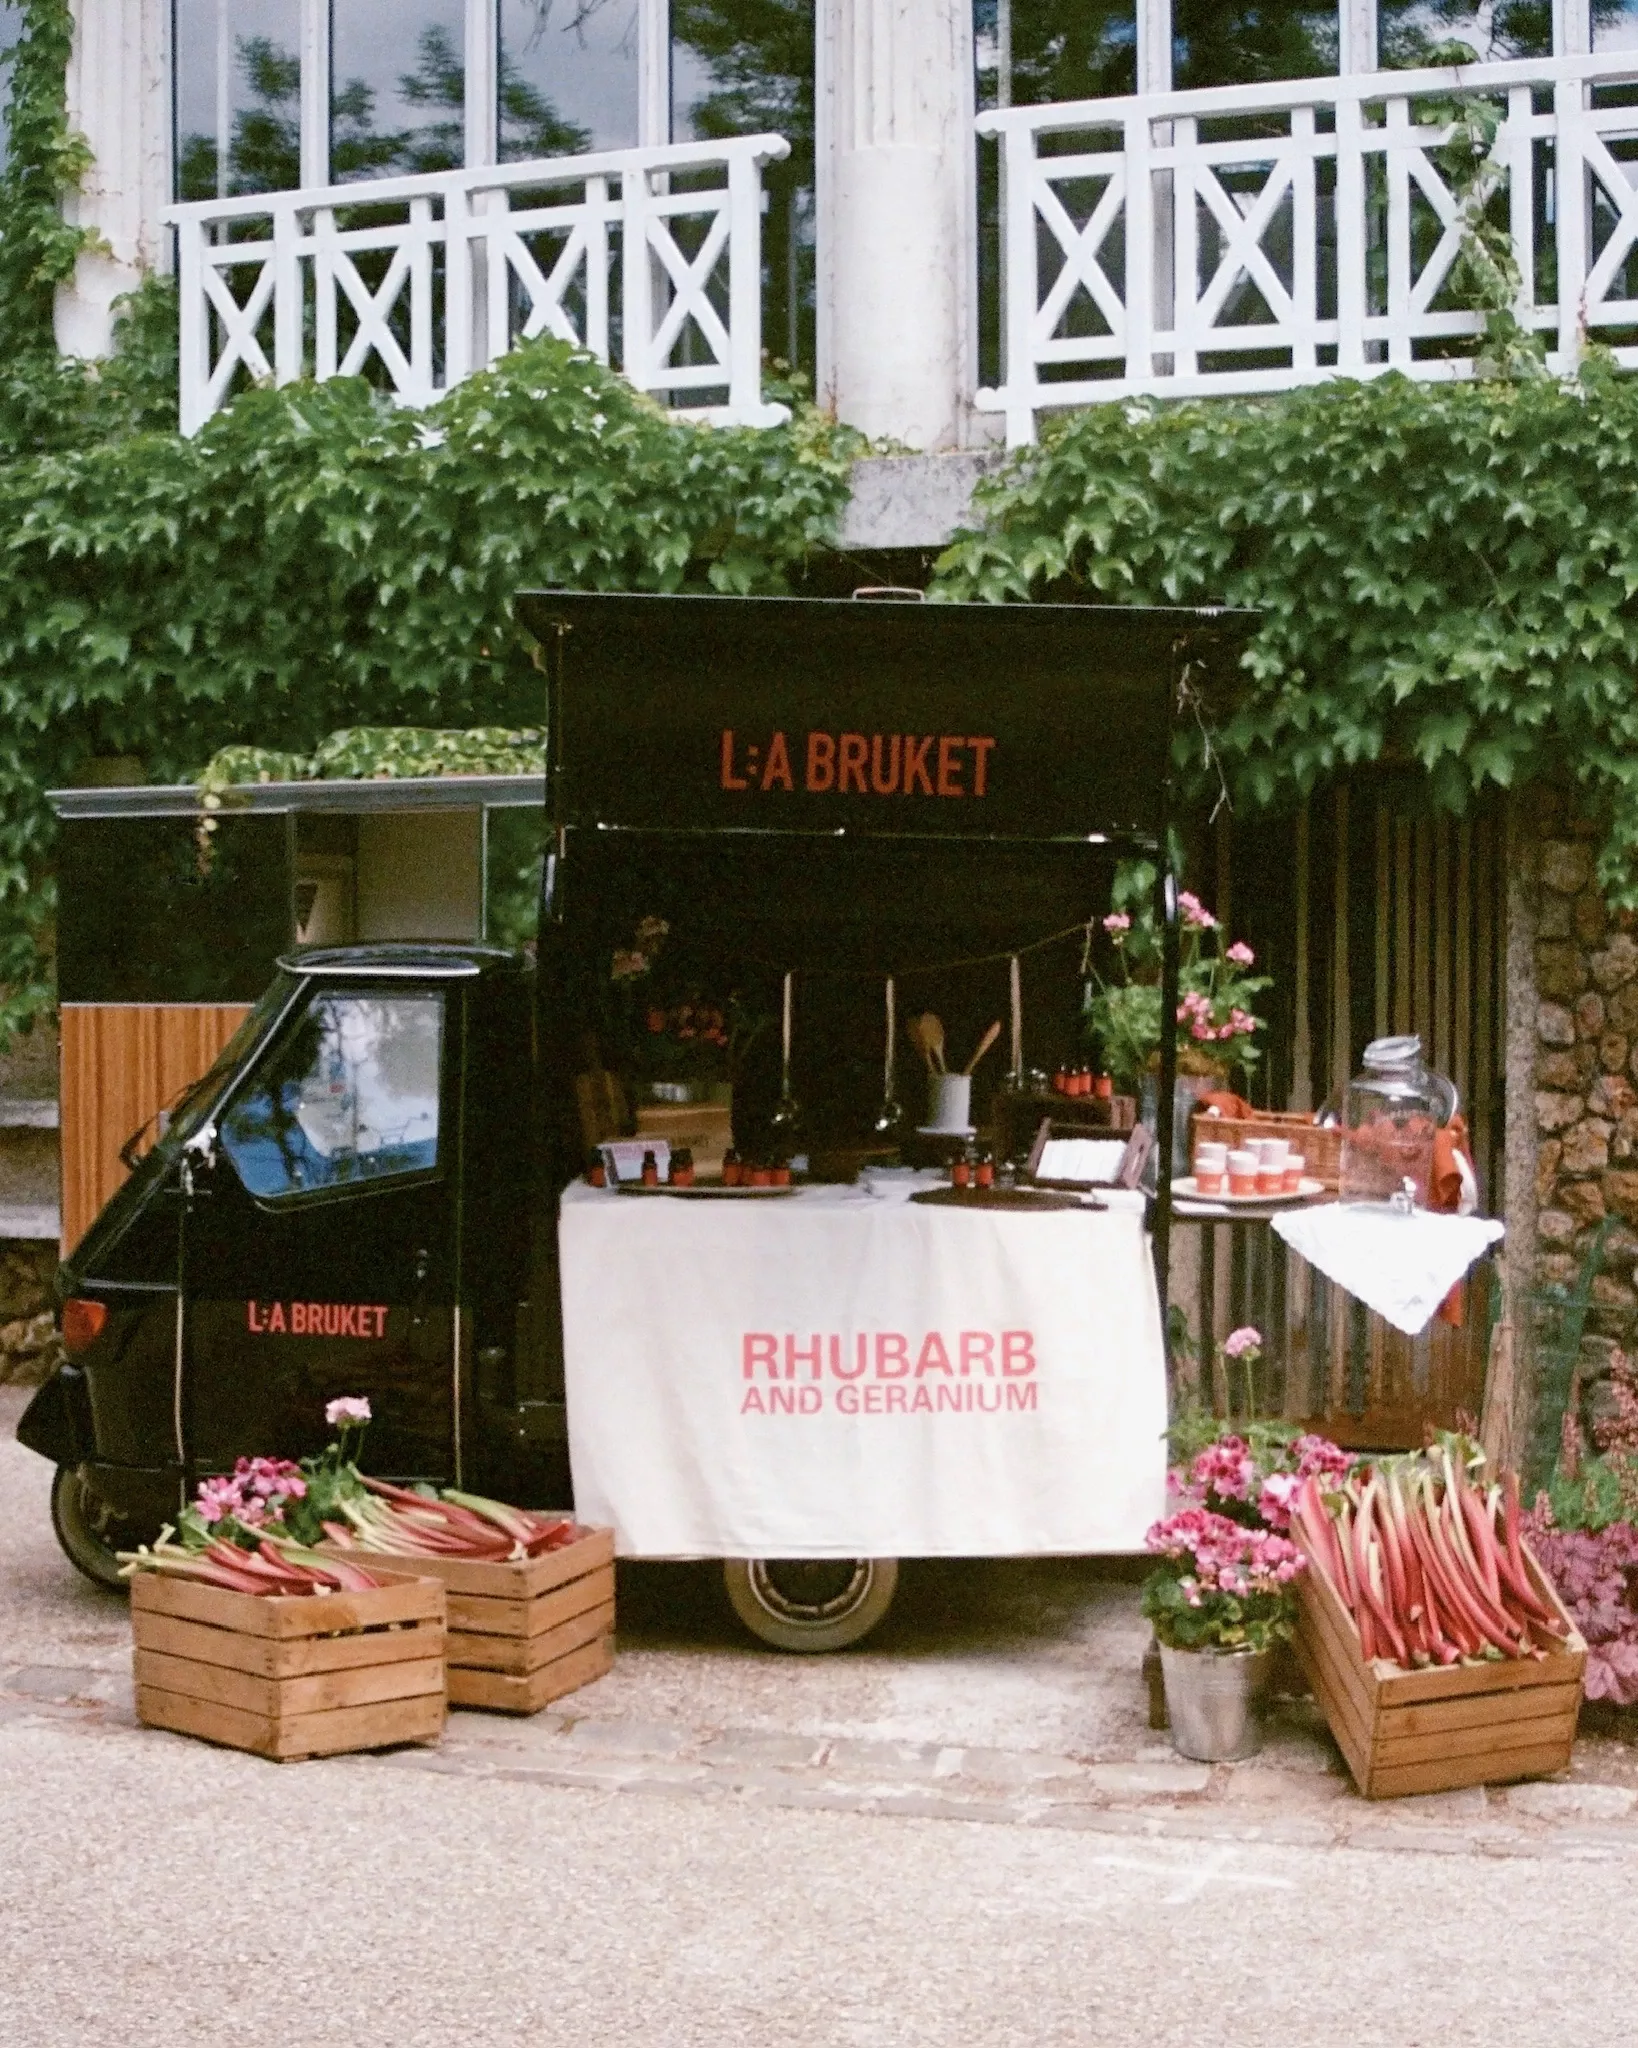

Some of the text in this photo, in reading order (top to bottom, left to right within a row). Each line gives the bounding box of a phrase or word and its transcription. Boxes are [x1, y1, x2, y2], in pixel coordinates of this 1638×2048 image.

[721, 731, 995, 796] L:A BRUKET
[248, 1301, 388, 1338] L:A BRUKET
[741, 1330, 1038, 1380] RHUBARB
[740, 1381, 1039, 1416] AND GERANIUM
